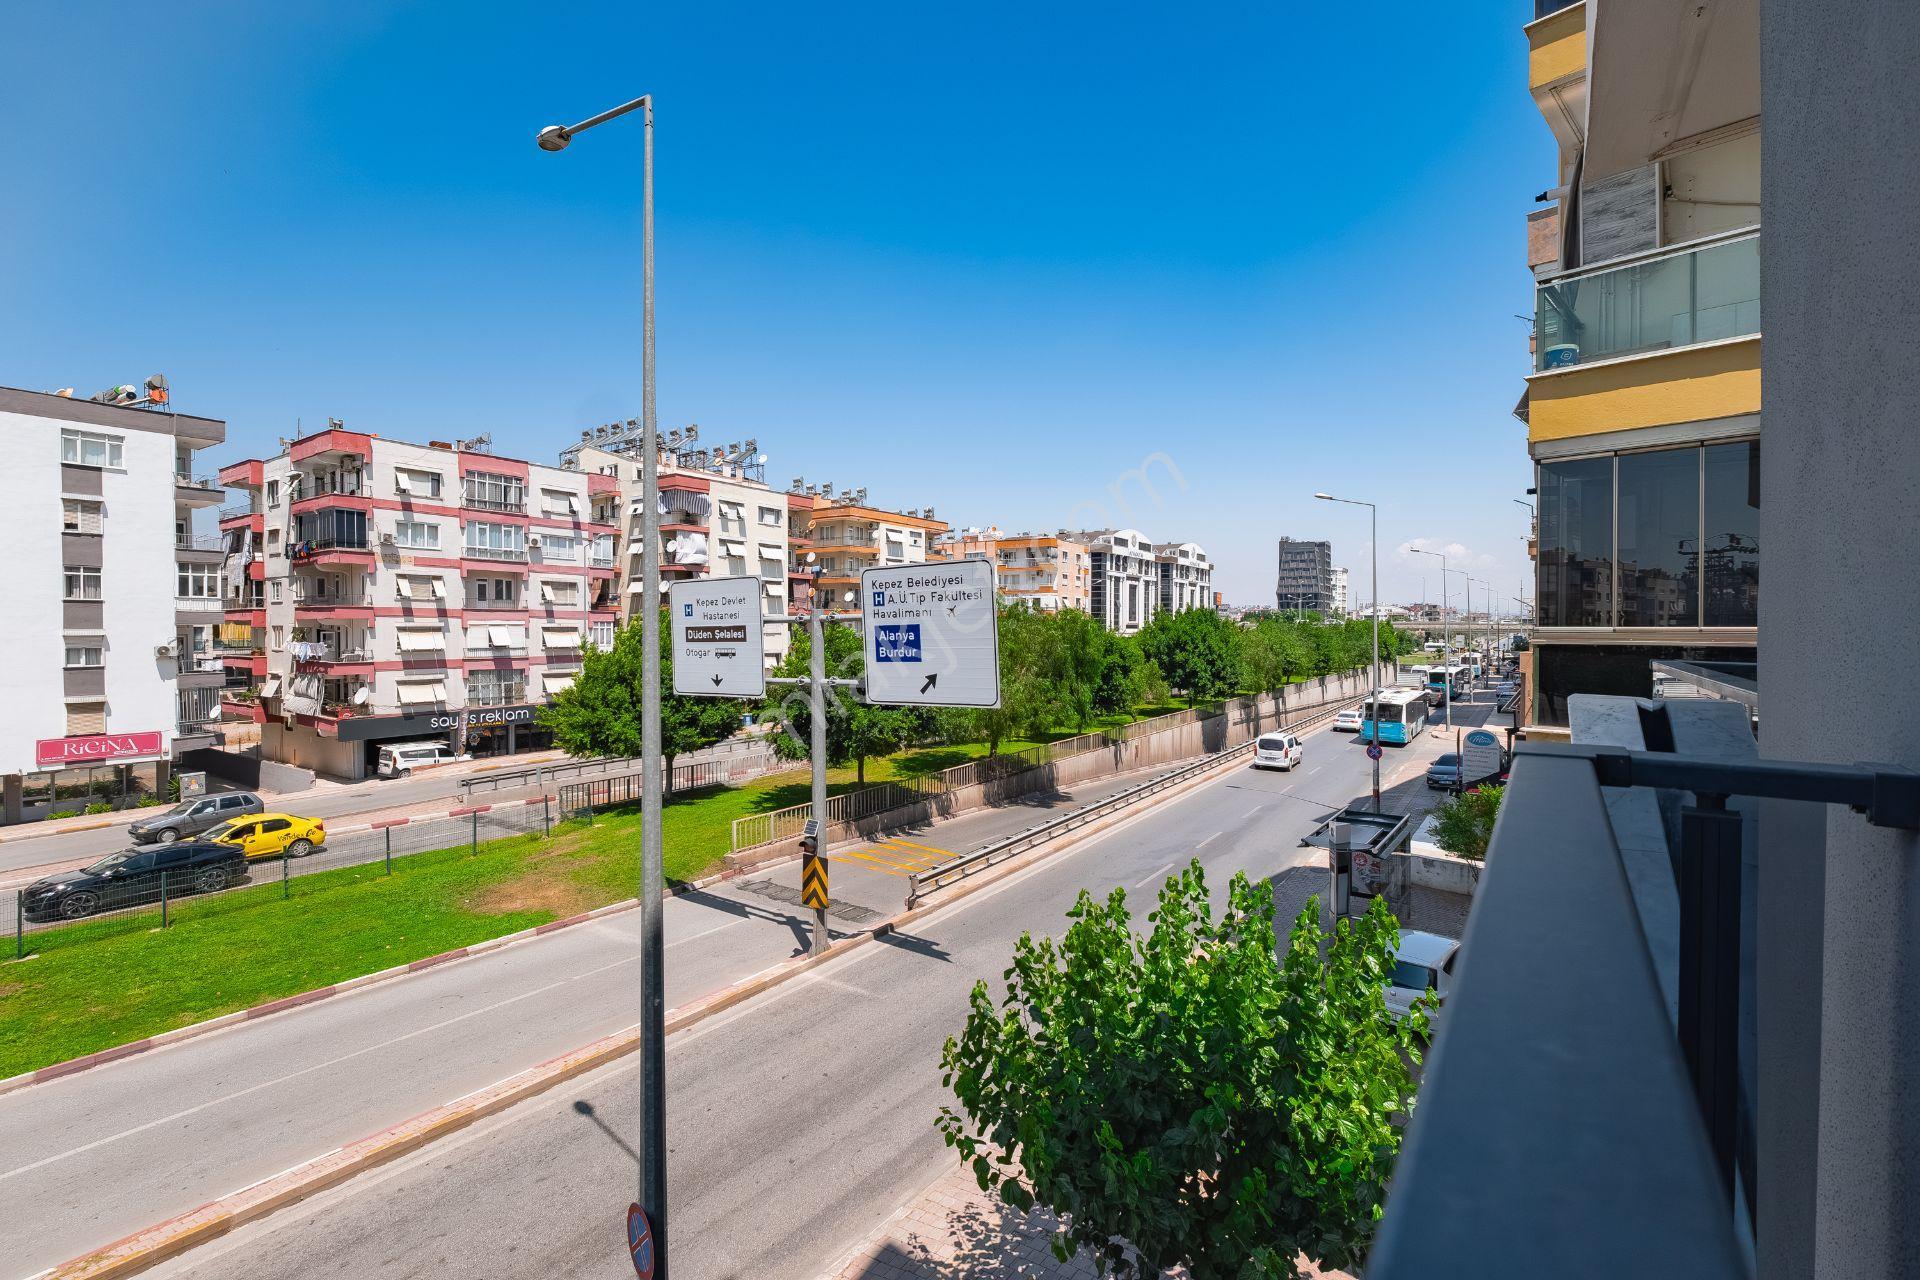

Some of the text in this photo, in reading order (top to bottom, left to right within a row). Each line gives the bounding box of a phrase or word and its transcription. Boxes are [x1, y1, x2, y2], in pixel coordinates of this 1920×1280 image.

[871, 574, 963, 591] Kepez Belediyesi
[696, 596, 746, 608] Kepez Devlet
[931, 589, 983, 603] Fakültesi
[703, 610, 740, 620] Hastanesi
[873, 608, 932, 619] Havalimanı
[687, 629, 745, 640] Düden Şelalesi
[879, 630, 915, 643] Alanya
[685, 648, 711, 659] Otogar
[879, 646, 917, 658] Burdur
[430, 713, 477, 729] says
[480, 709, 529, 724] reklam
